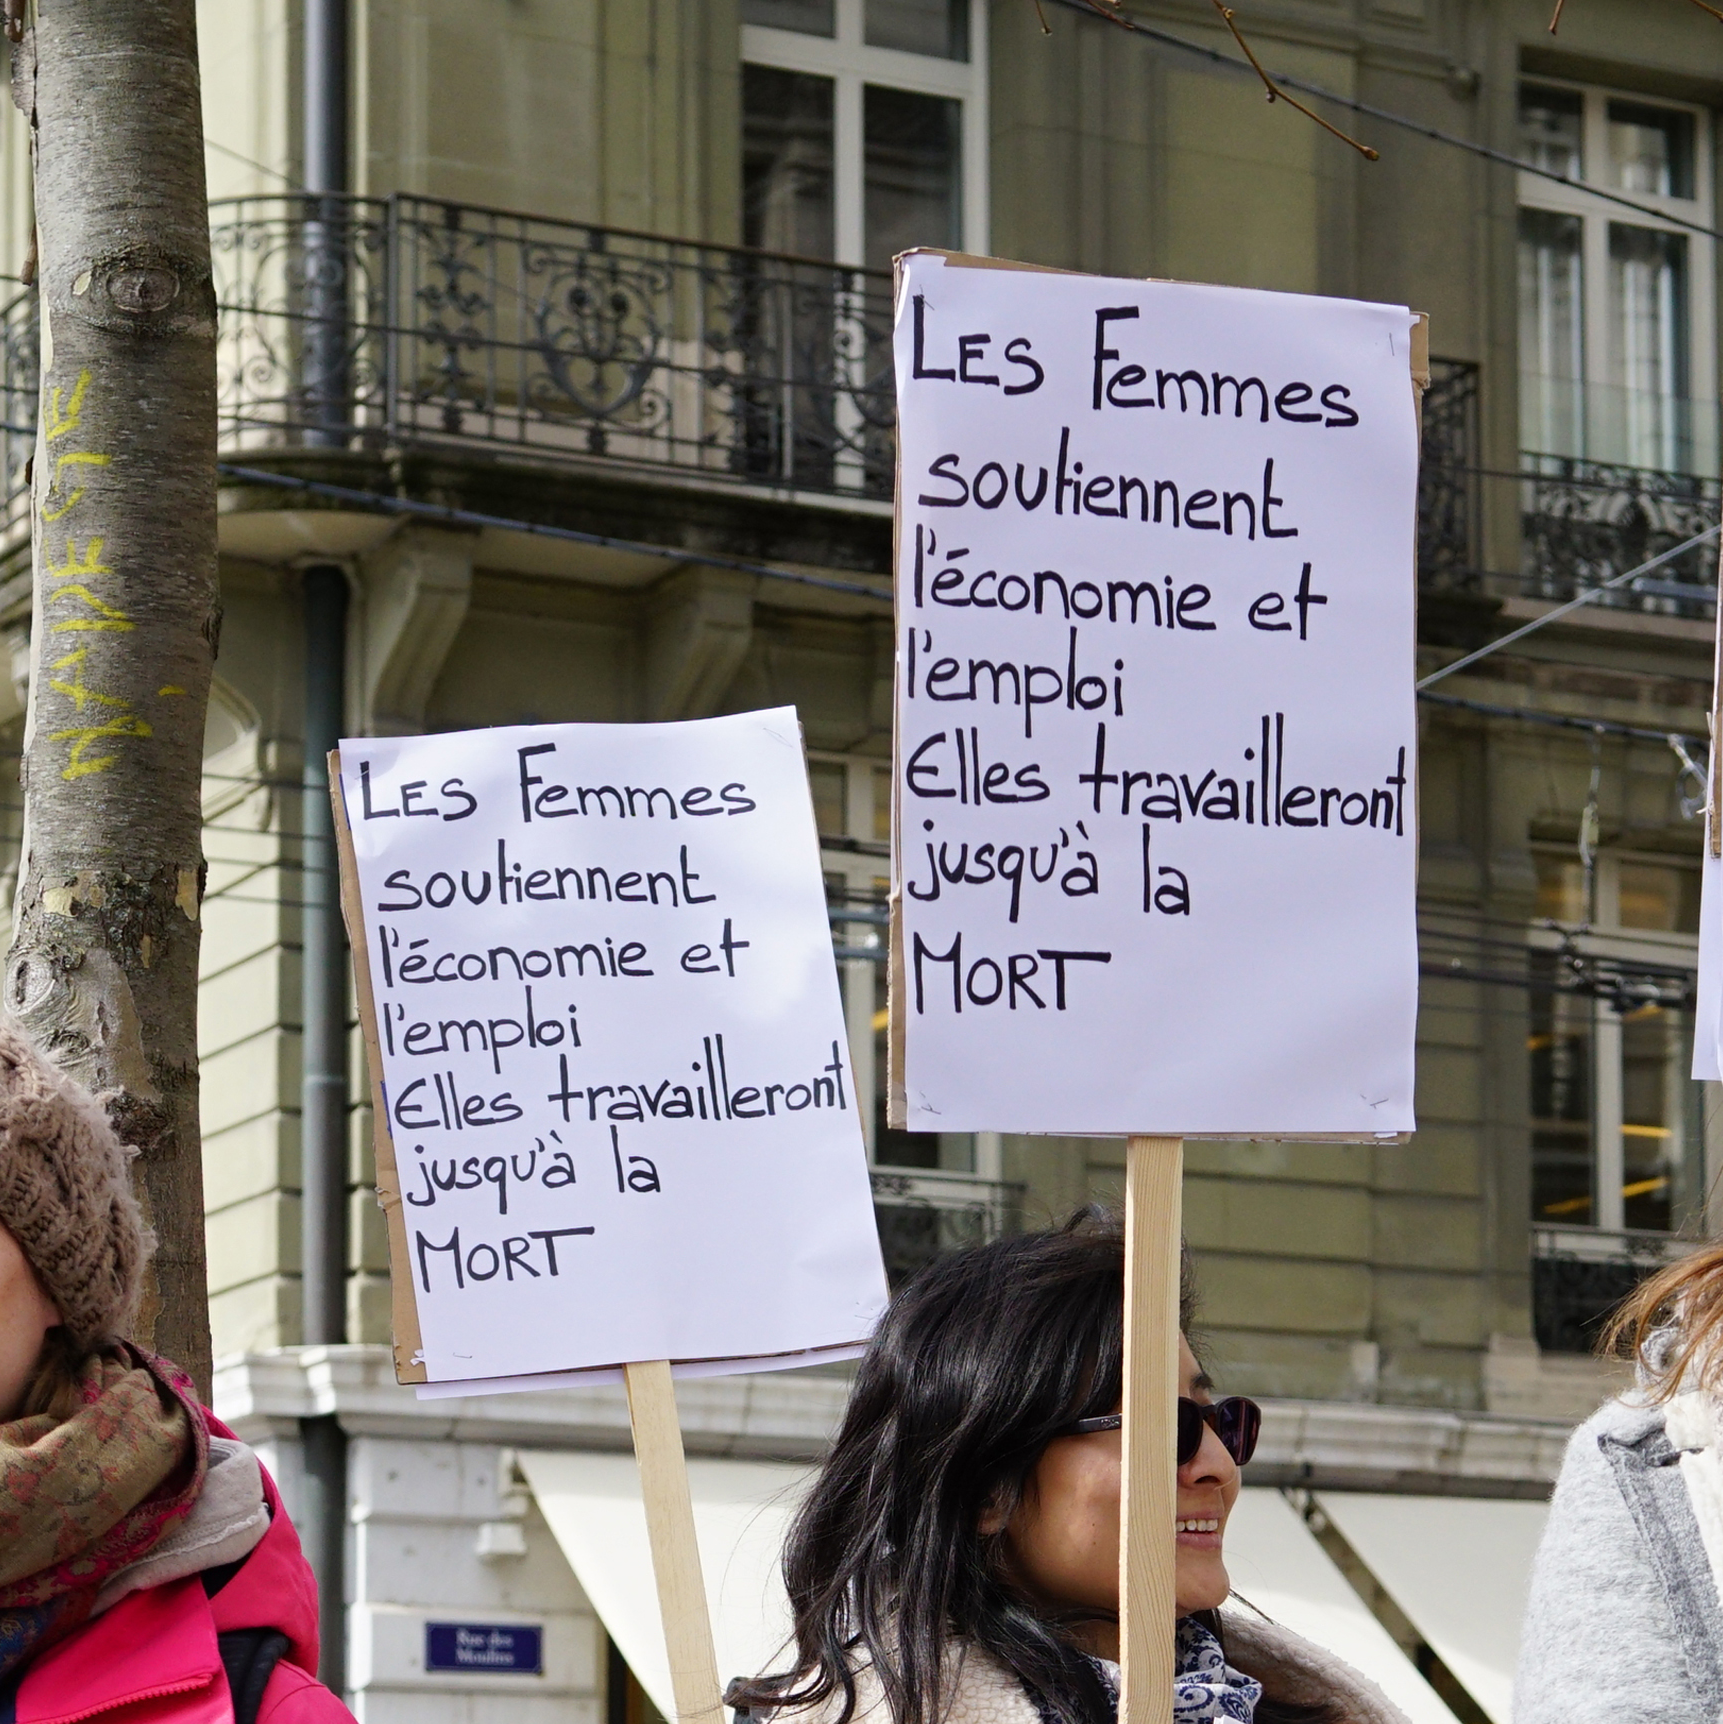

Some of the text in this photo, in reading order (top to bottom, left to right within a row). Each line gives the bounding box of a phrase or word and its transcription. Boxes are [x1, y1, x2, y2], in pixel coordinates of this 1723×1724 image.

[1092, 305, 1360, 429] Femmes
[917, 427, 1299, 540] soutiennent
[913, 524, 1328, 641] l'économie et
[906, 625, 1125, 737] l'emploi
[517, 742, 757, 823] Femmes
[904, 711, 1407, 837] Elles travailleront
[378, 837, 717, 912] soutiennent
[908, 819, 1192, 923] jusqu'à la
[378, 917, 751, 988] l'économie et
[911, 930, 1112, 1015] MORT
[382, 985, 581, 1074] l'emploi
[393, 1032, 849, 1131] Elles travailleront
[407, 1124, 662, 1215] jusqu'à la
[413, 1225, 595, 1293] MORT
[456, 1629, 485, 1648] Rue
